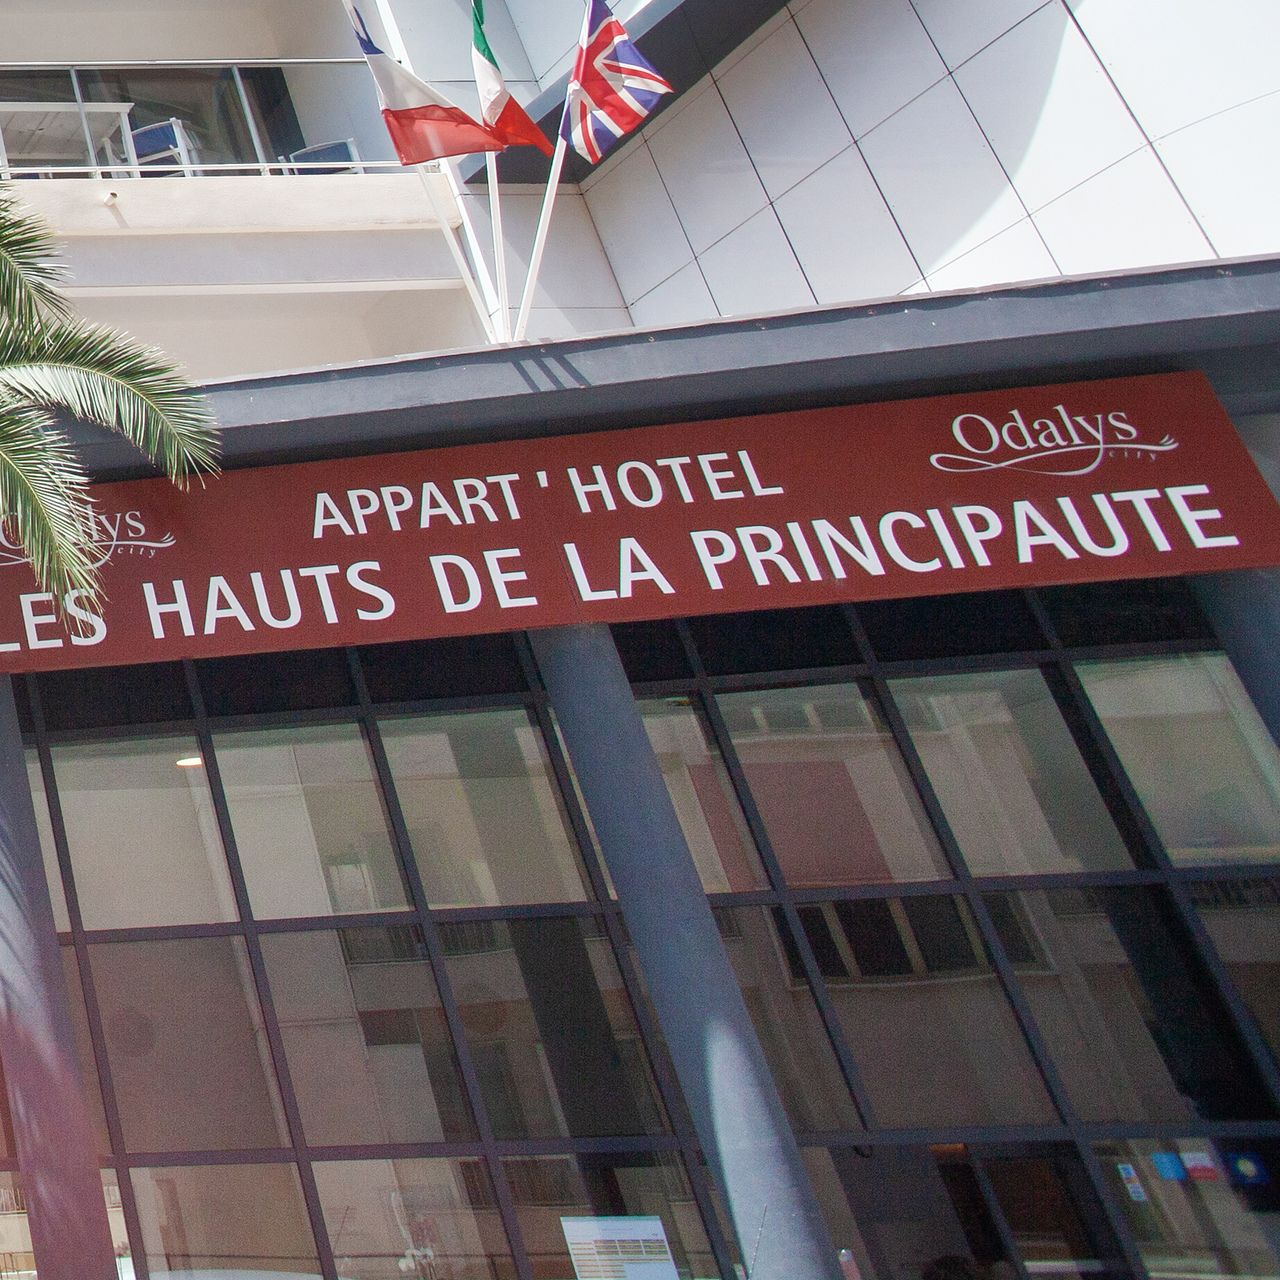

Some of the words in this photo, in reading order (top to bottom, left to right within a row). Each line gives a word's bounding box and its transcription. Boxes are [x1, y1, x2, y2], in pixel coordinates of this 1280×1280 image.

[951, 404, 1138, 476] Odalys
[1108, 448, 1158, 462] city
[566, 449, 785, 513] HOTEL
[117, 545, 157, 560] city
[142, 560, 396, 639] HAUTS
[428, 547, 539, 614] DE
[562, 536, 677, 602] LA
[689, 483, 1240, 591] PRINCIPAUTE
